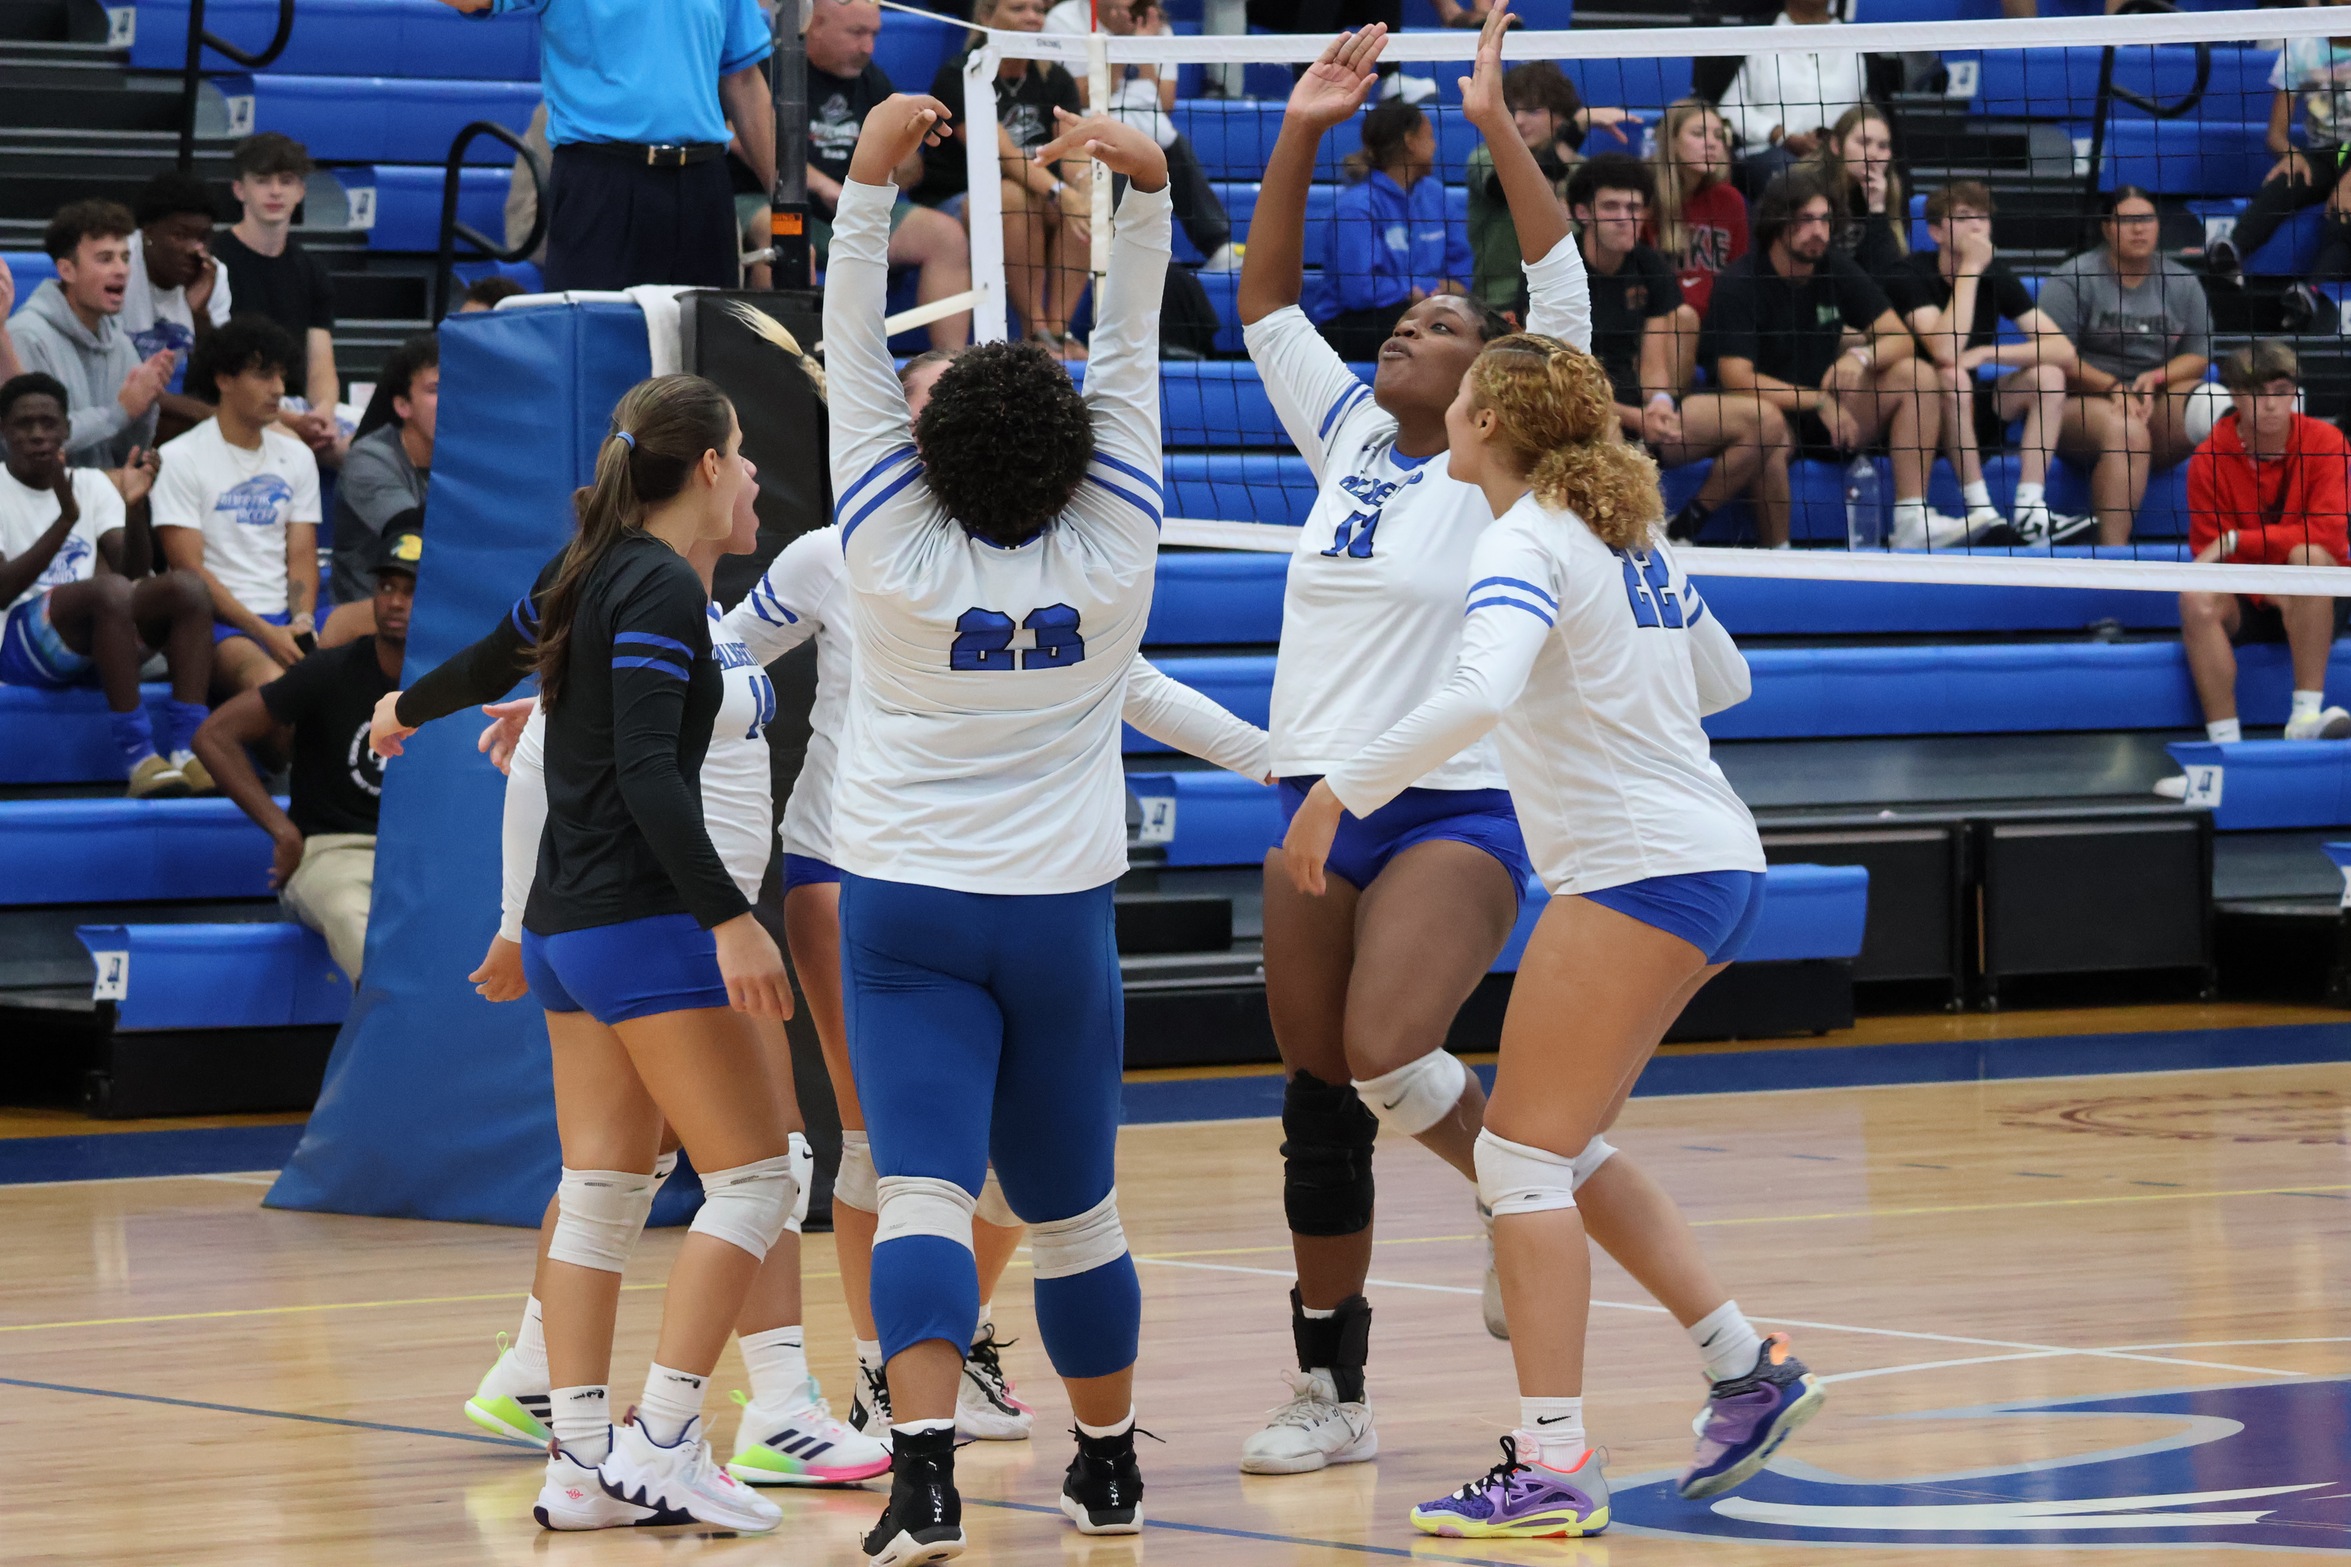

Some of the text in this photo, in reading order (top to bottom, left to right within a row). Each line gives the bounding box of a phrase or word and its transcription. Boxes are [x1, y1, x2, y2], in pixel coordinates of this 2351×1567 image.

[1320, 509, 1382, 559] 11
[1606, 543, 1684, 629] 22
[950, 602, 1086, 671] 23
